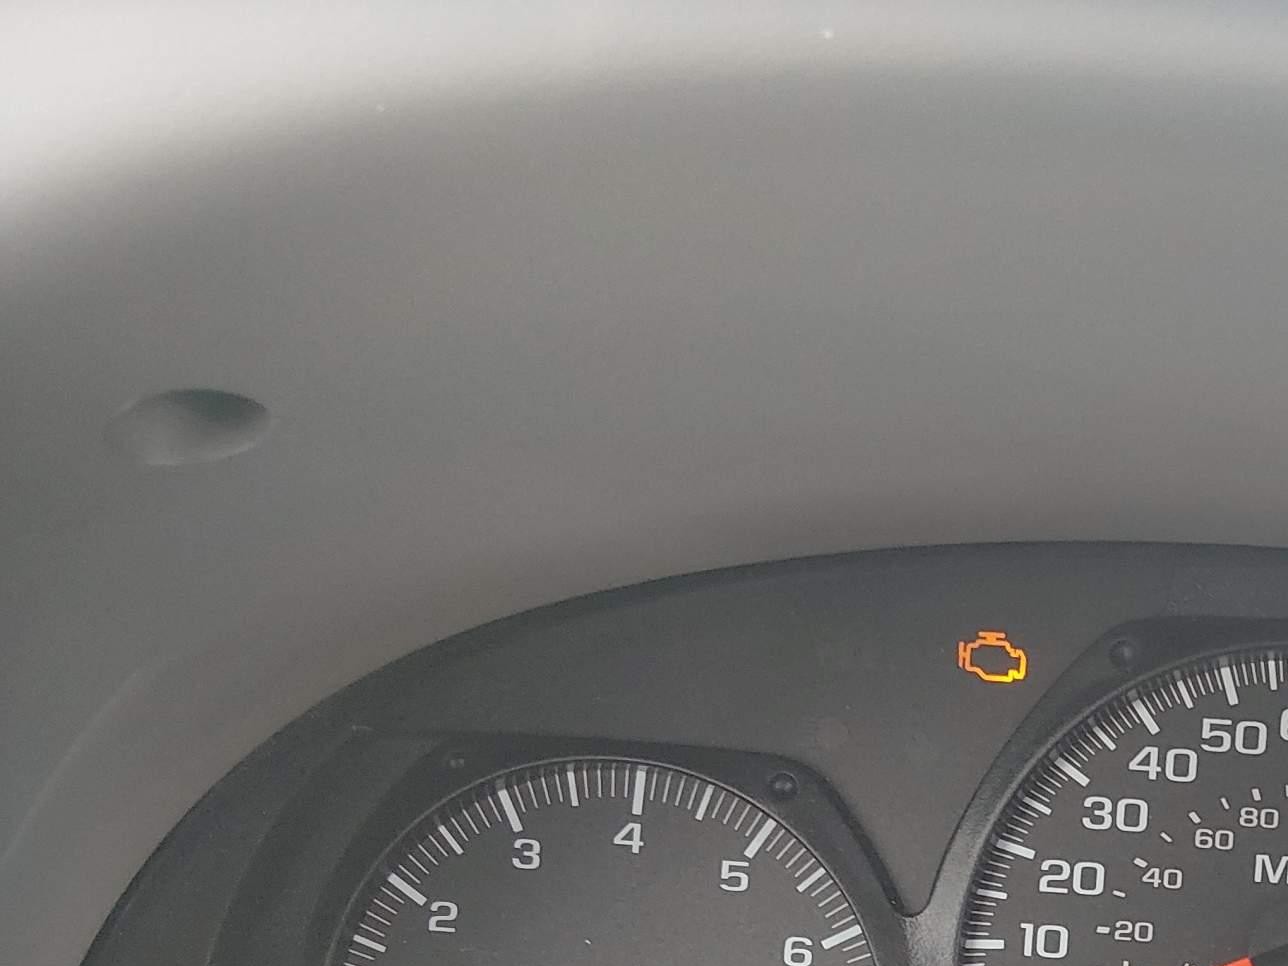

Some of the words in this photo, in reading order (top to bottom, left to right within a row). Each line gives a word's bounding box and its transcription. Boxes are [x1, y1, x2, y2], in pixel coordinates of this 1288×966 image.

[1201, 718, 1267, 754] 50
[1129, 747, 1197, 782] 40
[1083, 797, 1148, 831] 30
[1240, 807, 1278, 828] 80
[614, 823, 643, 853] 4
[1195, 829, 1233, 849] 60
[512, 839, 540, 869] 3
[720, 861, 749, 891] 5
[1039, 860, 1104, 895] 20
[1142, 868, 1182, 888] 40
[429, 902, 457, 932] 2
[1115, 921, 1153, 941] 20
[784, 937, 812, 966] 6
[1021, 923, 1068, 958] 10
